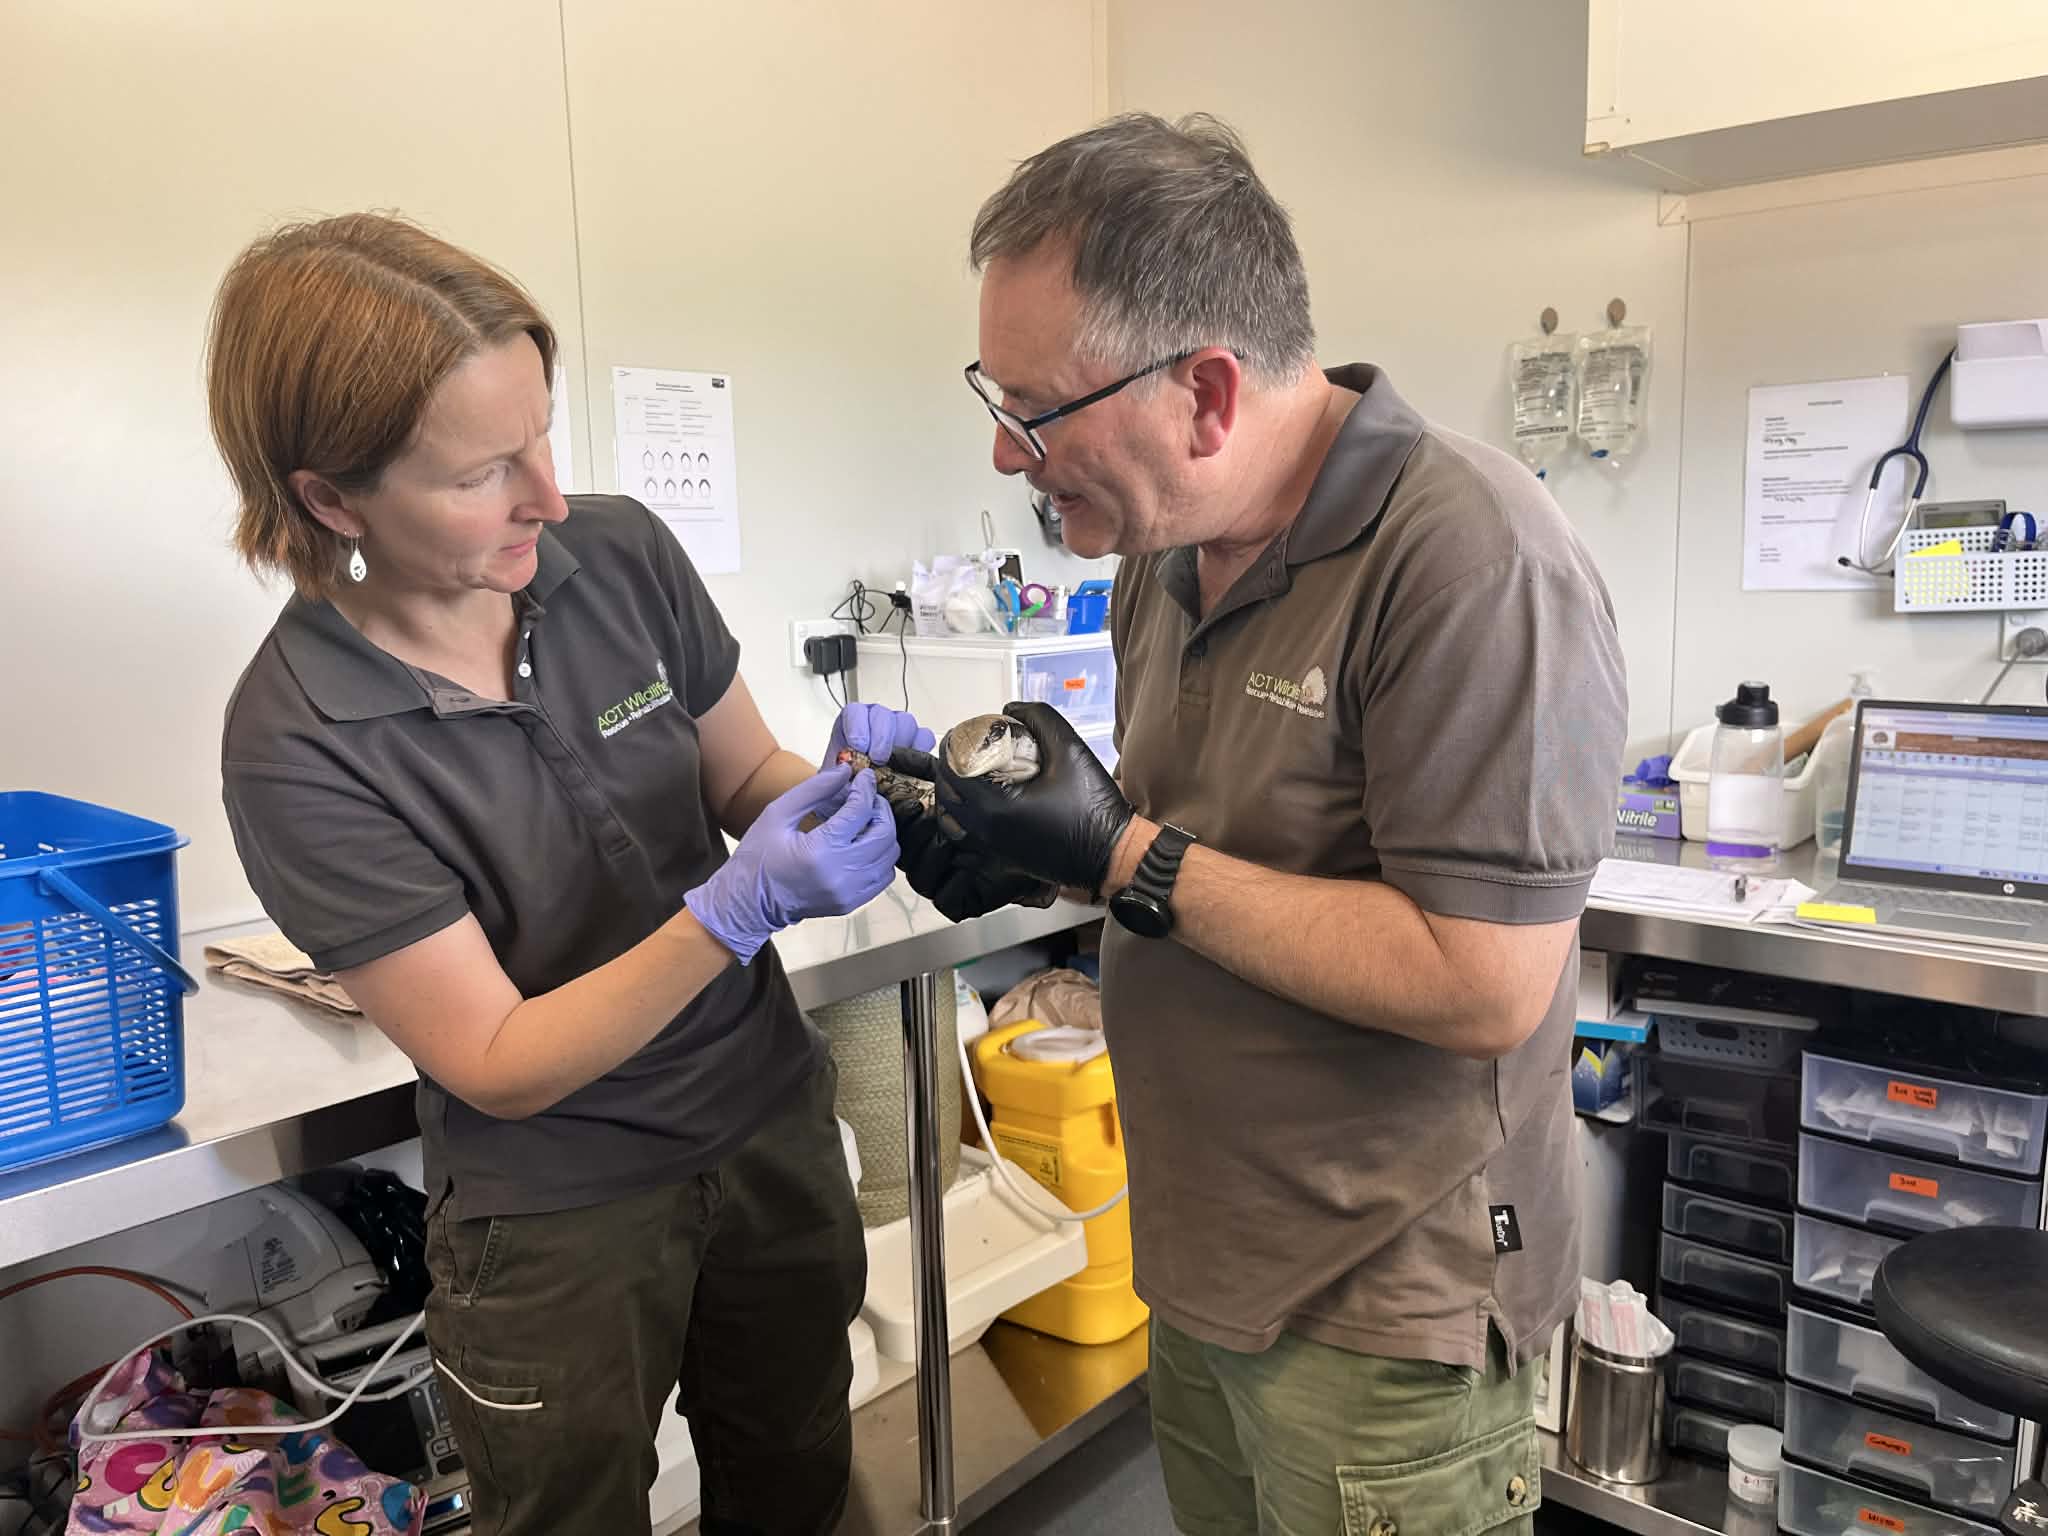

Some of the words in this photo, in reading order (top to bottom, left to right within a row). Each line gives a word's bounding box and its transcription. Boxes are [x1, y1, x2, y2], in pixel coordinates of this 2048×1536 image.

[1247, 671, 1274, 690] ACT
[598, 703, 625, 731] ACT
[1616, 808, 1657, 827] Nitrile
